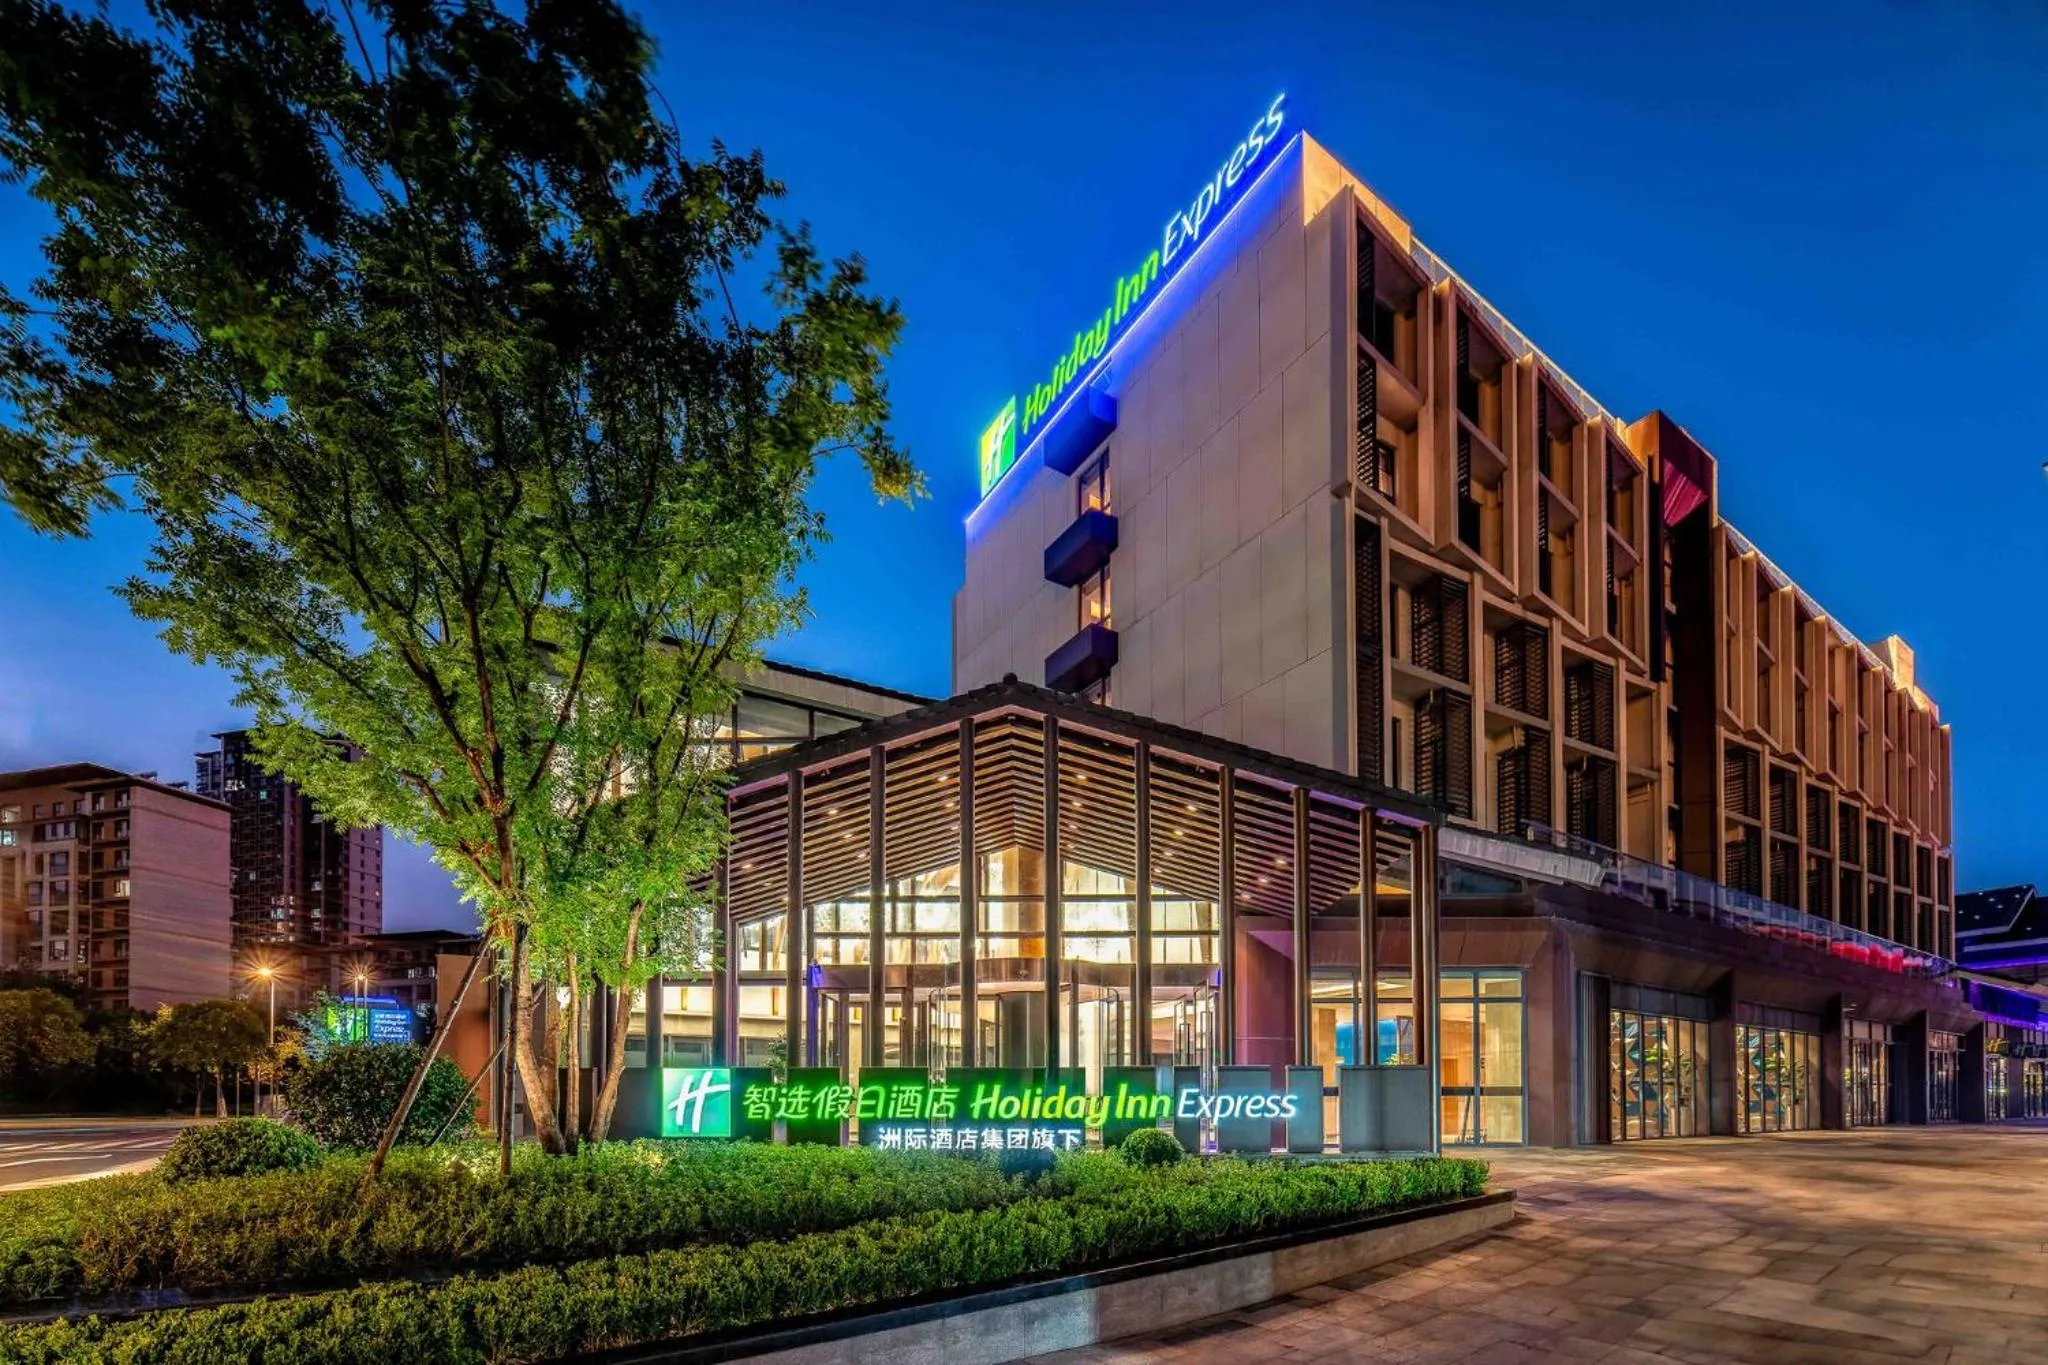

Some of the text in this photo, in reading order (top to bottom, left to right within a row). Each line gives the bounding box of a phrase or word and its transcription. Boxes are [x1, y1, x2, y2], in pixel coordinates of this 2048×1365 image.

[1022, 307, 1112, 435] Holiday
[1114, 249, 1160, 326] Inn
[1162, 92, 1286, 267] Express
[743, 1084, 961, 1120] 智选假日酒店
[970, 1084, 1111, 1128] Holiday
[1114, 1083, 1172, 1119] Inn
[1177, 1088, 1298, 1126] Express
[878, 1126, 1081, 1151] 洲际酒店集团旗下
